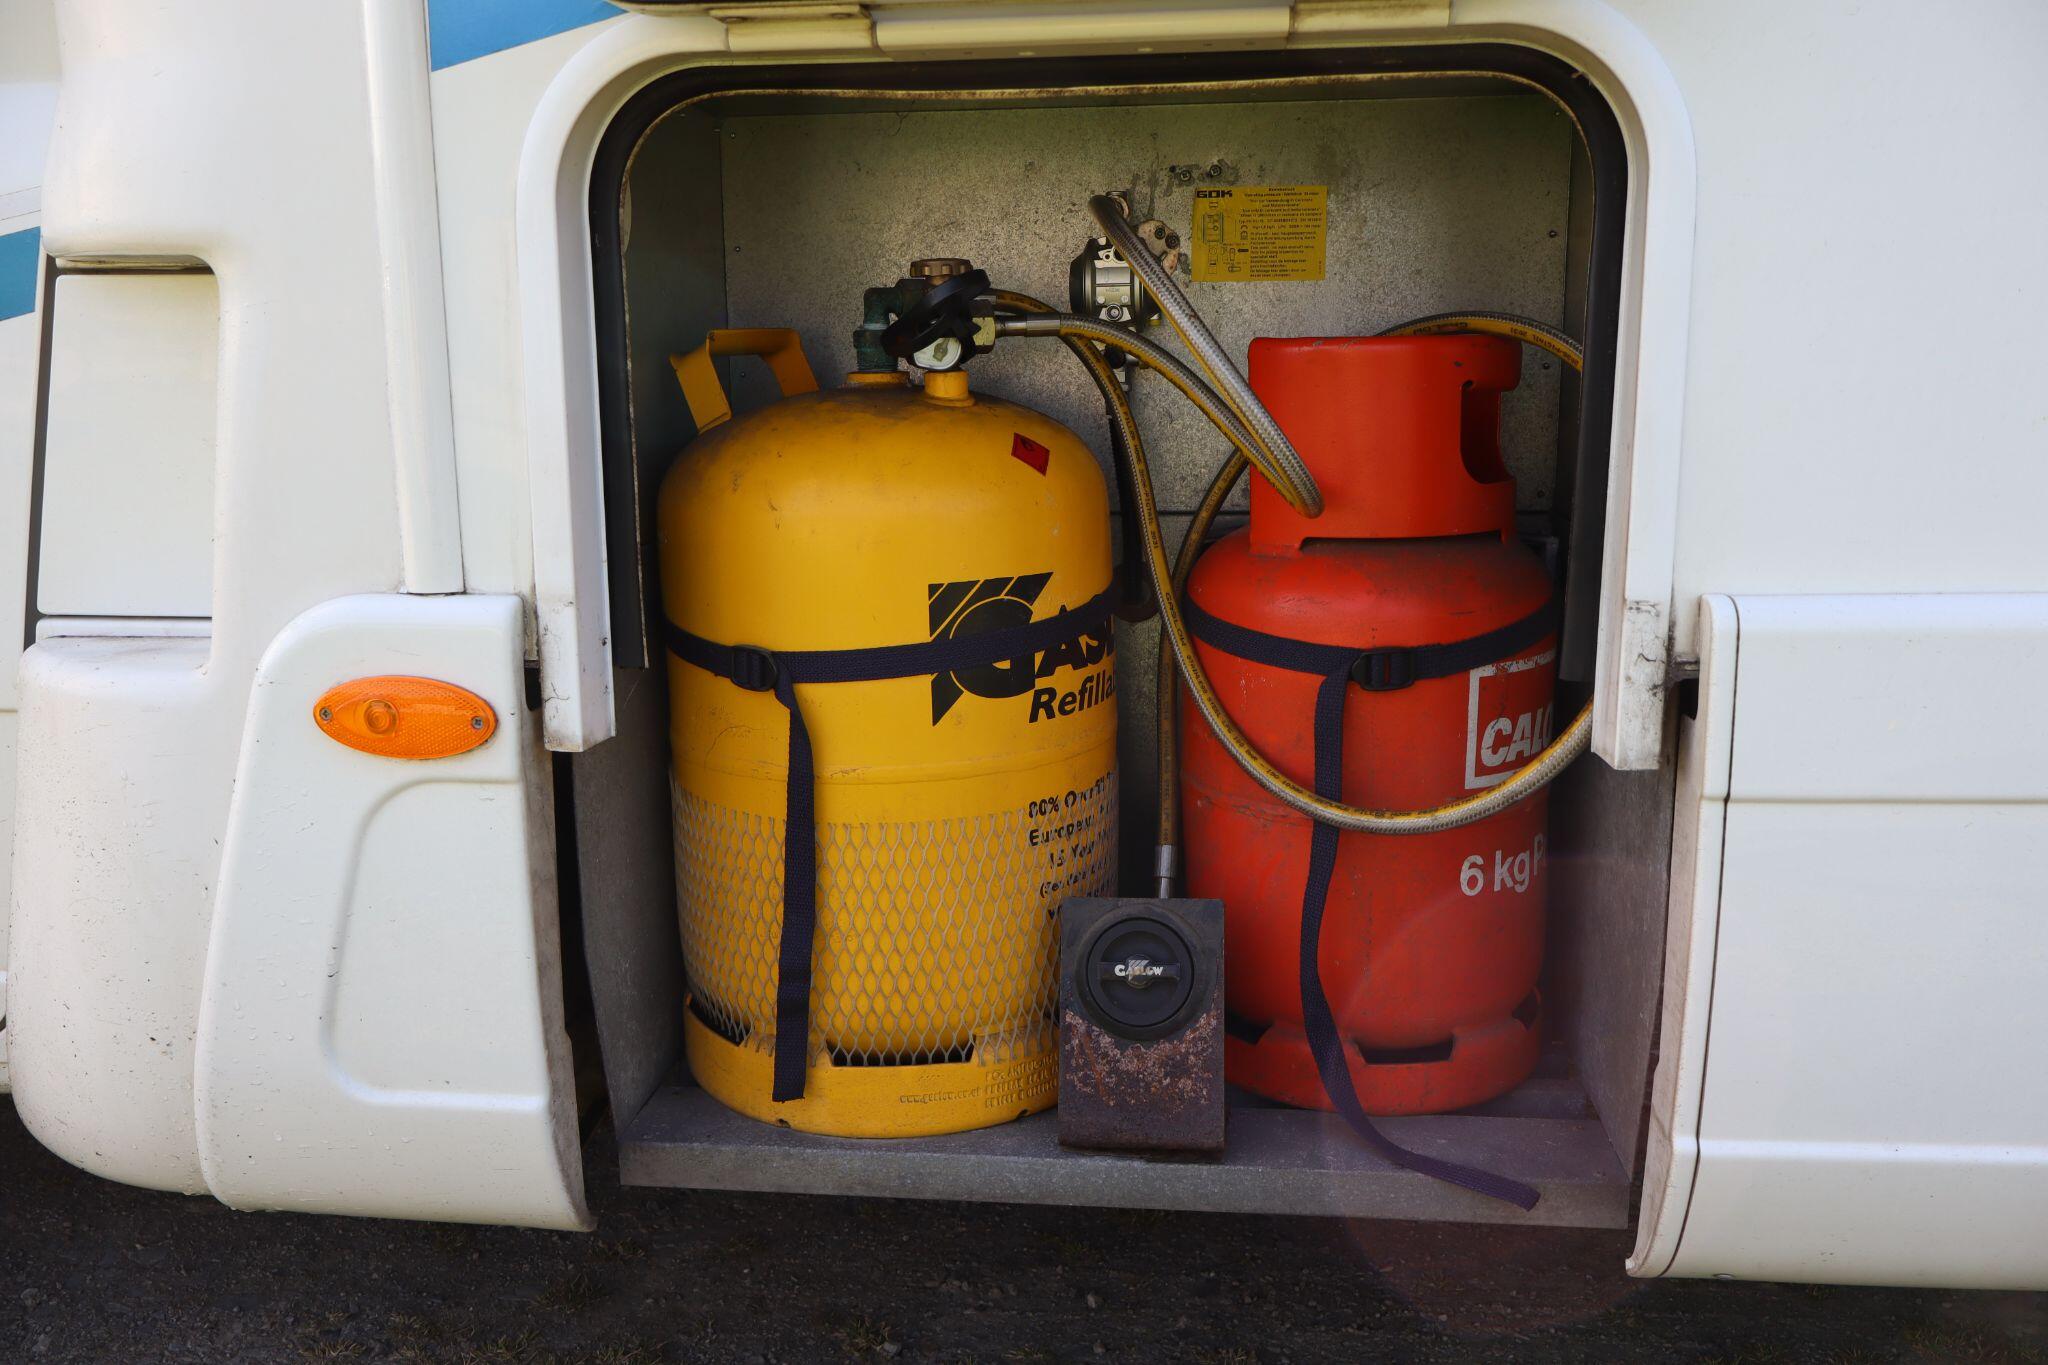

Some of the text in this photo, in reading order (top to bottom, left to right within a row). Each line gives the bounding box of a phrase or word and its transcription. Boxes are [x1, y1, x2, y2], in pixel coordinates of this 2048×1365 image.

[1196, 190, 1233, 198] GOK
[1164, 590, 1187, 646] GASLOW
[1029, 669, 1115, 724] Refilla
[1460, 855, 1484, 896] 6
[1493, 850, 1530, 893] kg
